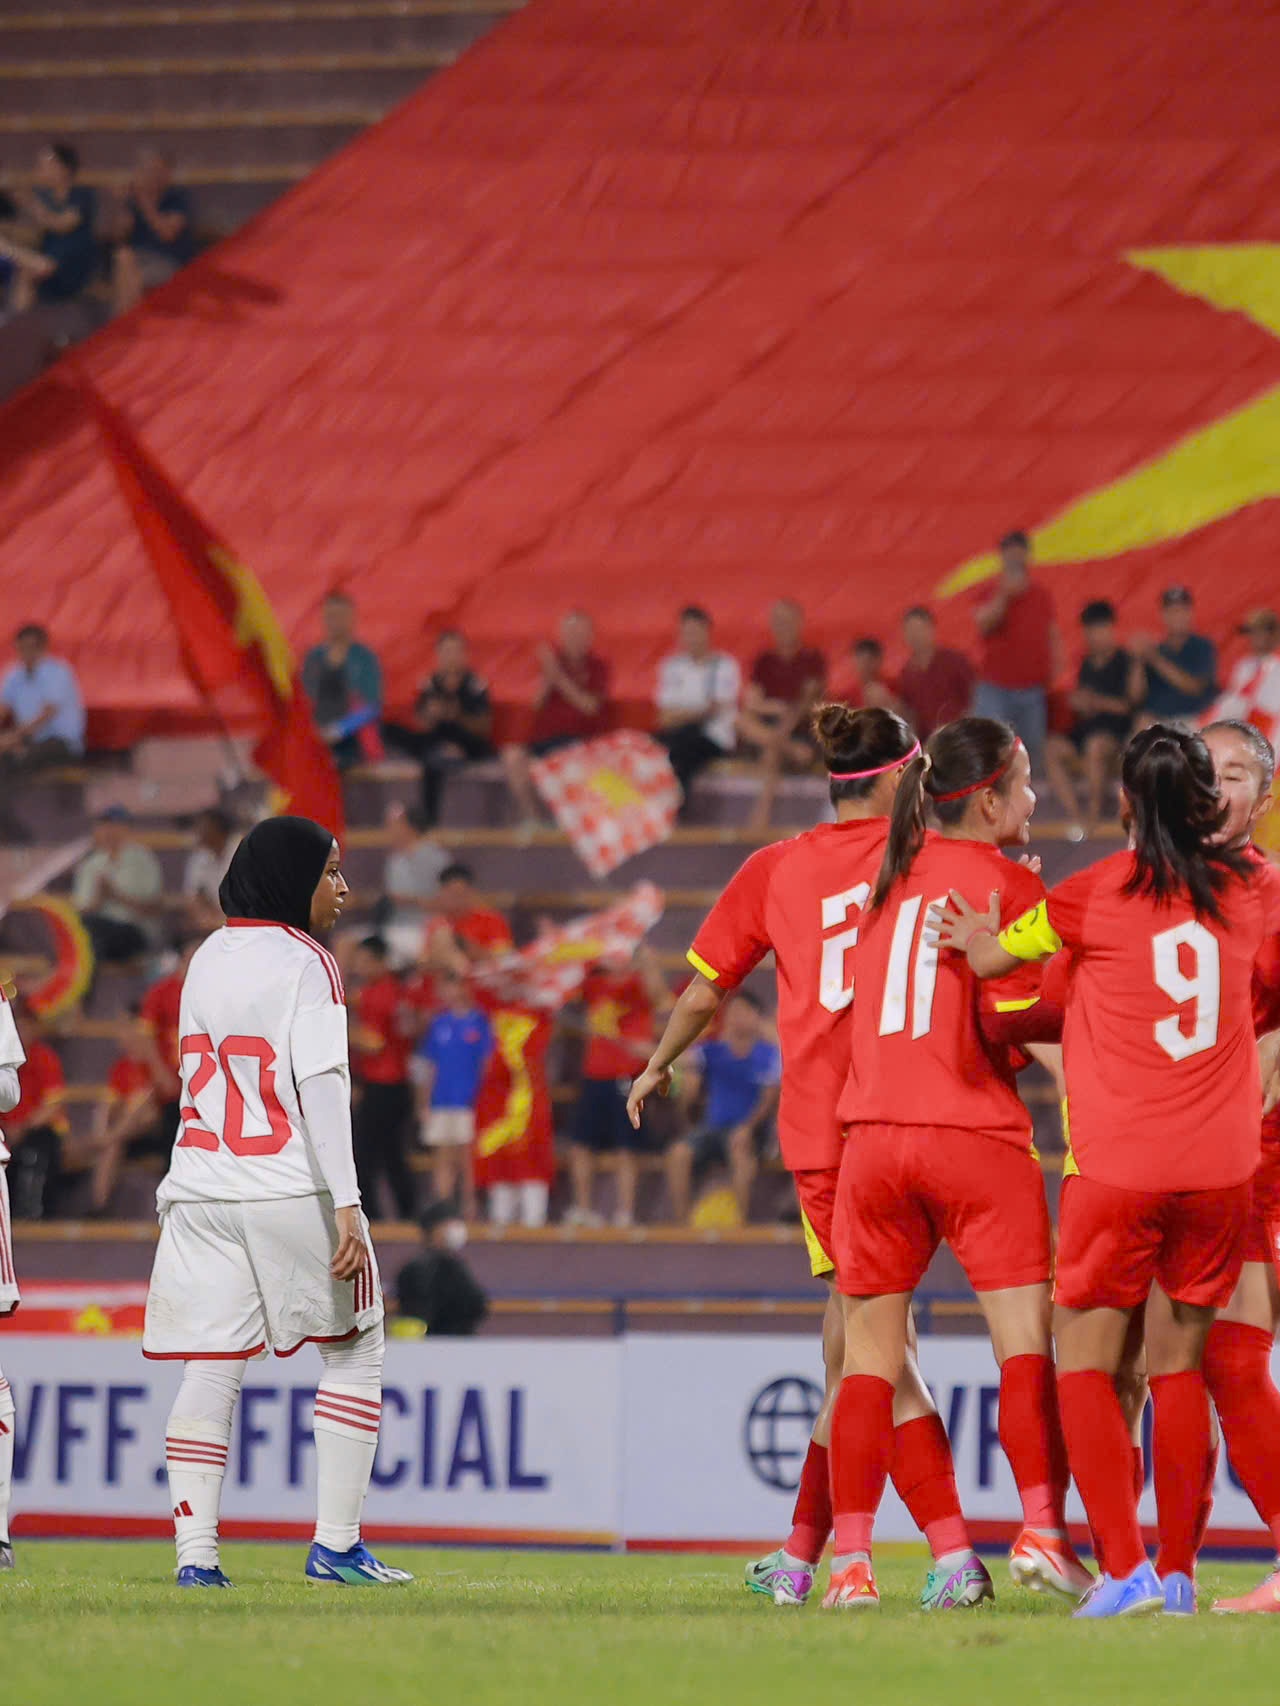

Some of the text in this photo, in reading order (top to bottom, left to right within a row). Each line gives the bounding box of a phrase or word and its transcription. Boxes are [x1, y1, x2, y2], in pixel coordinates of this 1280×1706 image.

[879, 894, 950, 1041] 11
[1153, 919, 1220, 1062] 9
[176, 1033, 293, 1157] 20
[12, 1383, 549, 1490] VFF.FFCIAL
